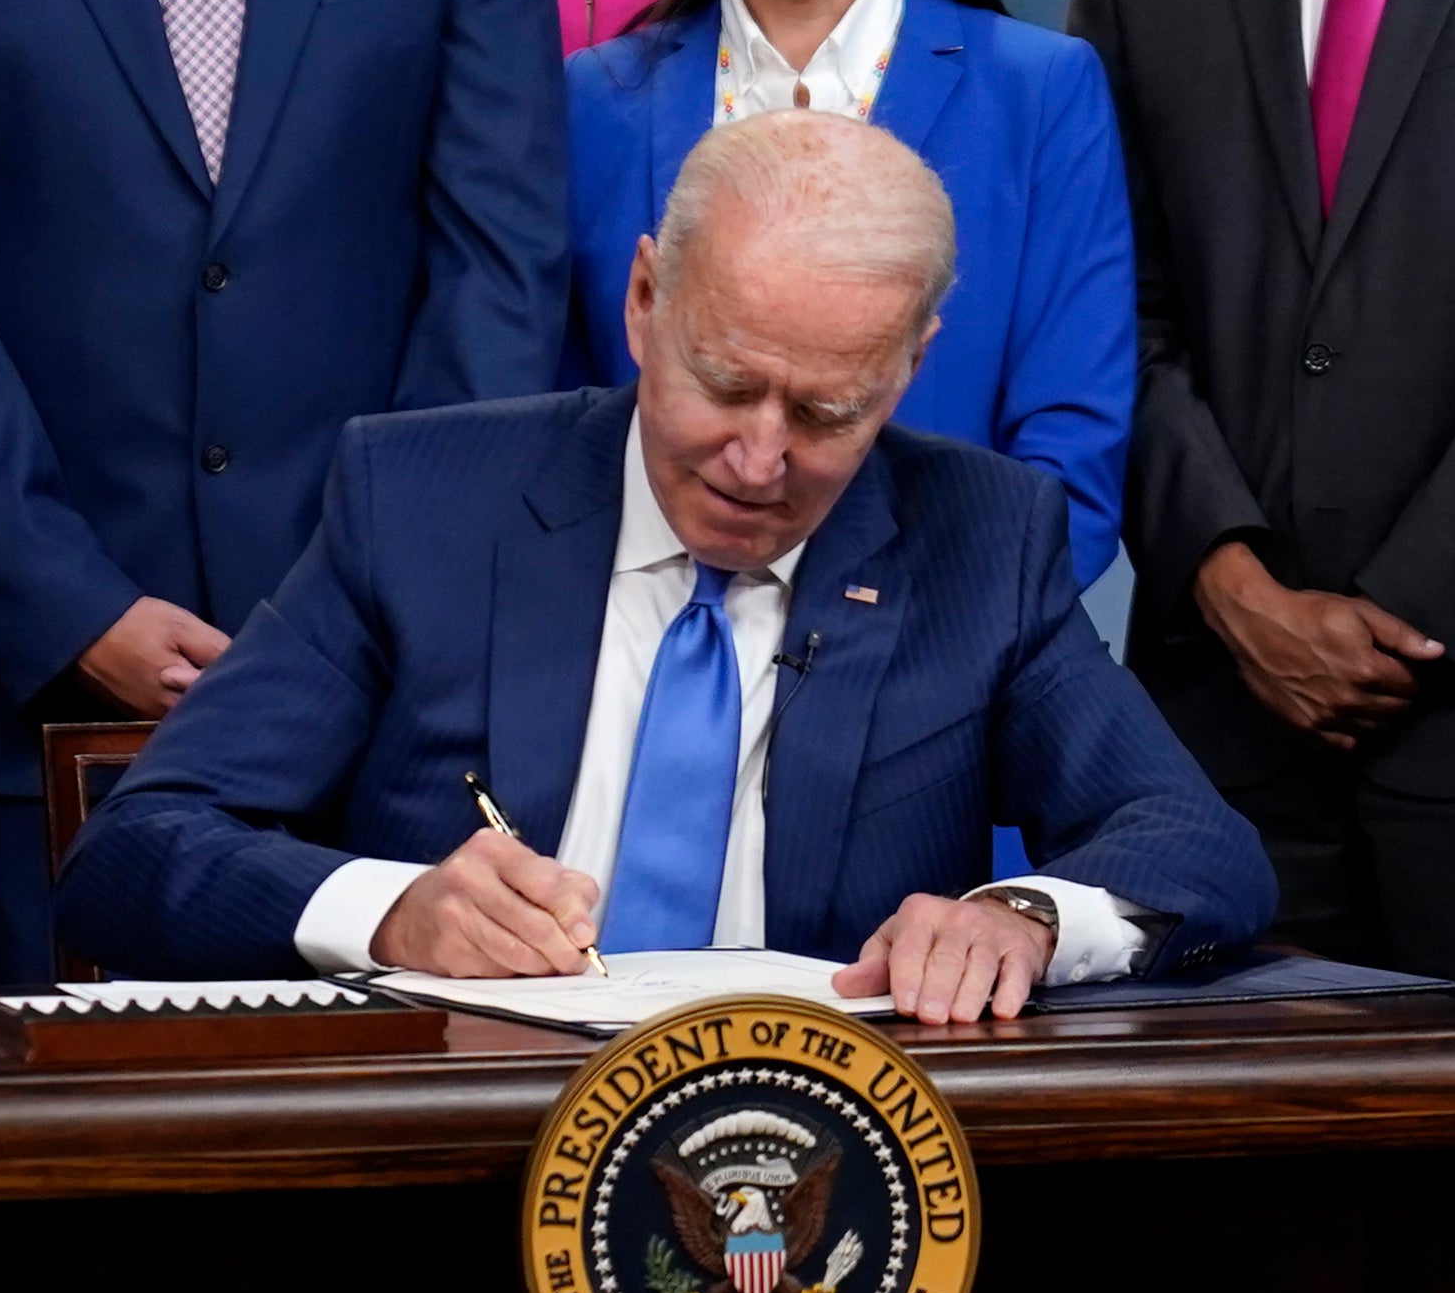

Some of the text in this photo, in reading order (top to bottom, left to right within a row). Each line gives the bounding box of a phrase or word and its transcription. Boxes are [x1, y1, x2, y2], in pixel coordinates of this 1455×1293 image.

[539, 1018, 733, 1228] PRESIDENT
[750, 1021, 791, 1048] OF
[801, 1027, 857, 1069] THE
[868, 1062, 965, 1243] UNITED
